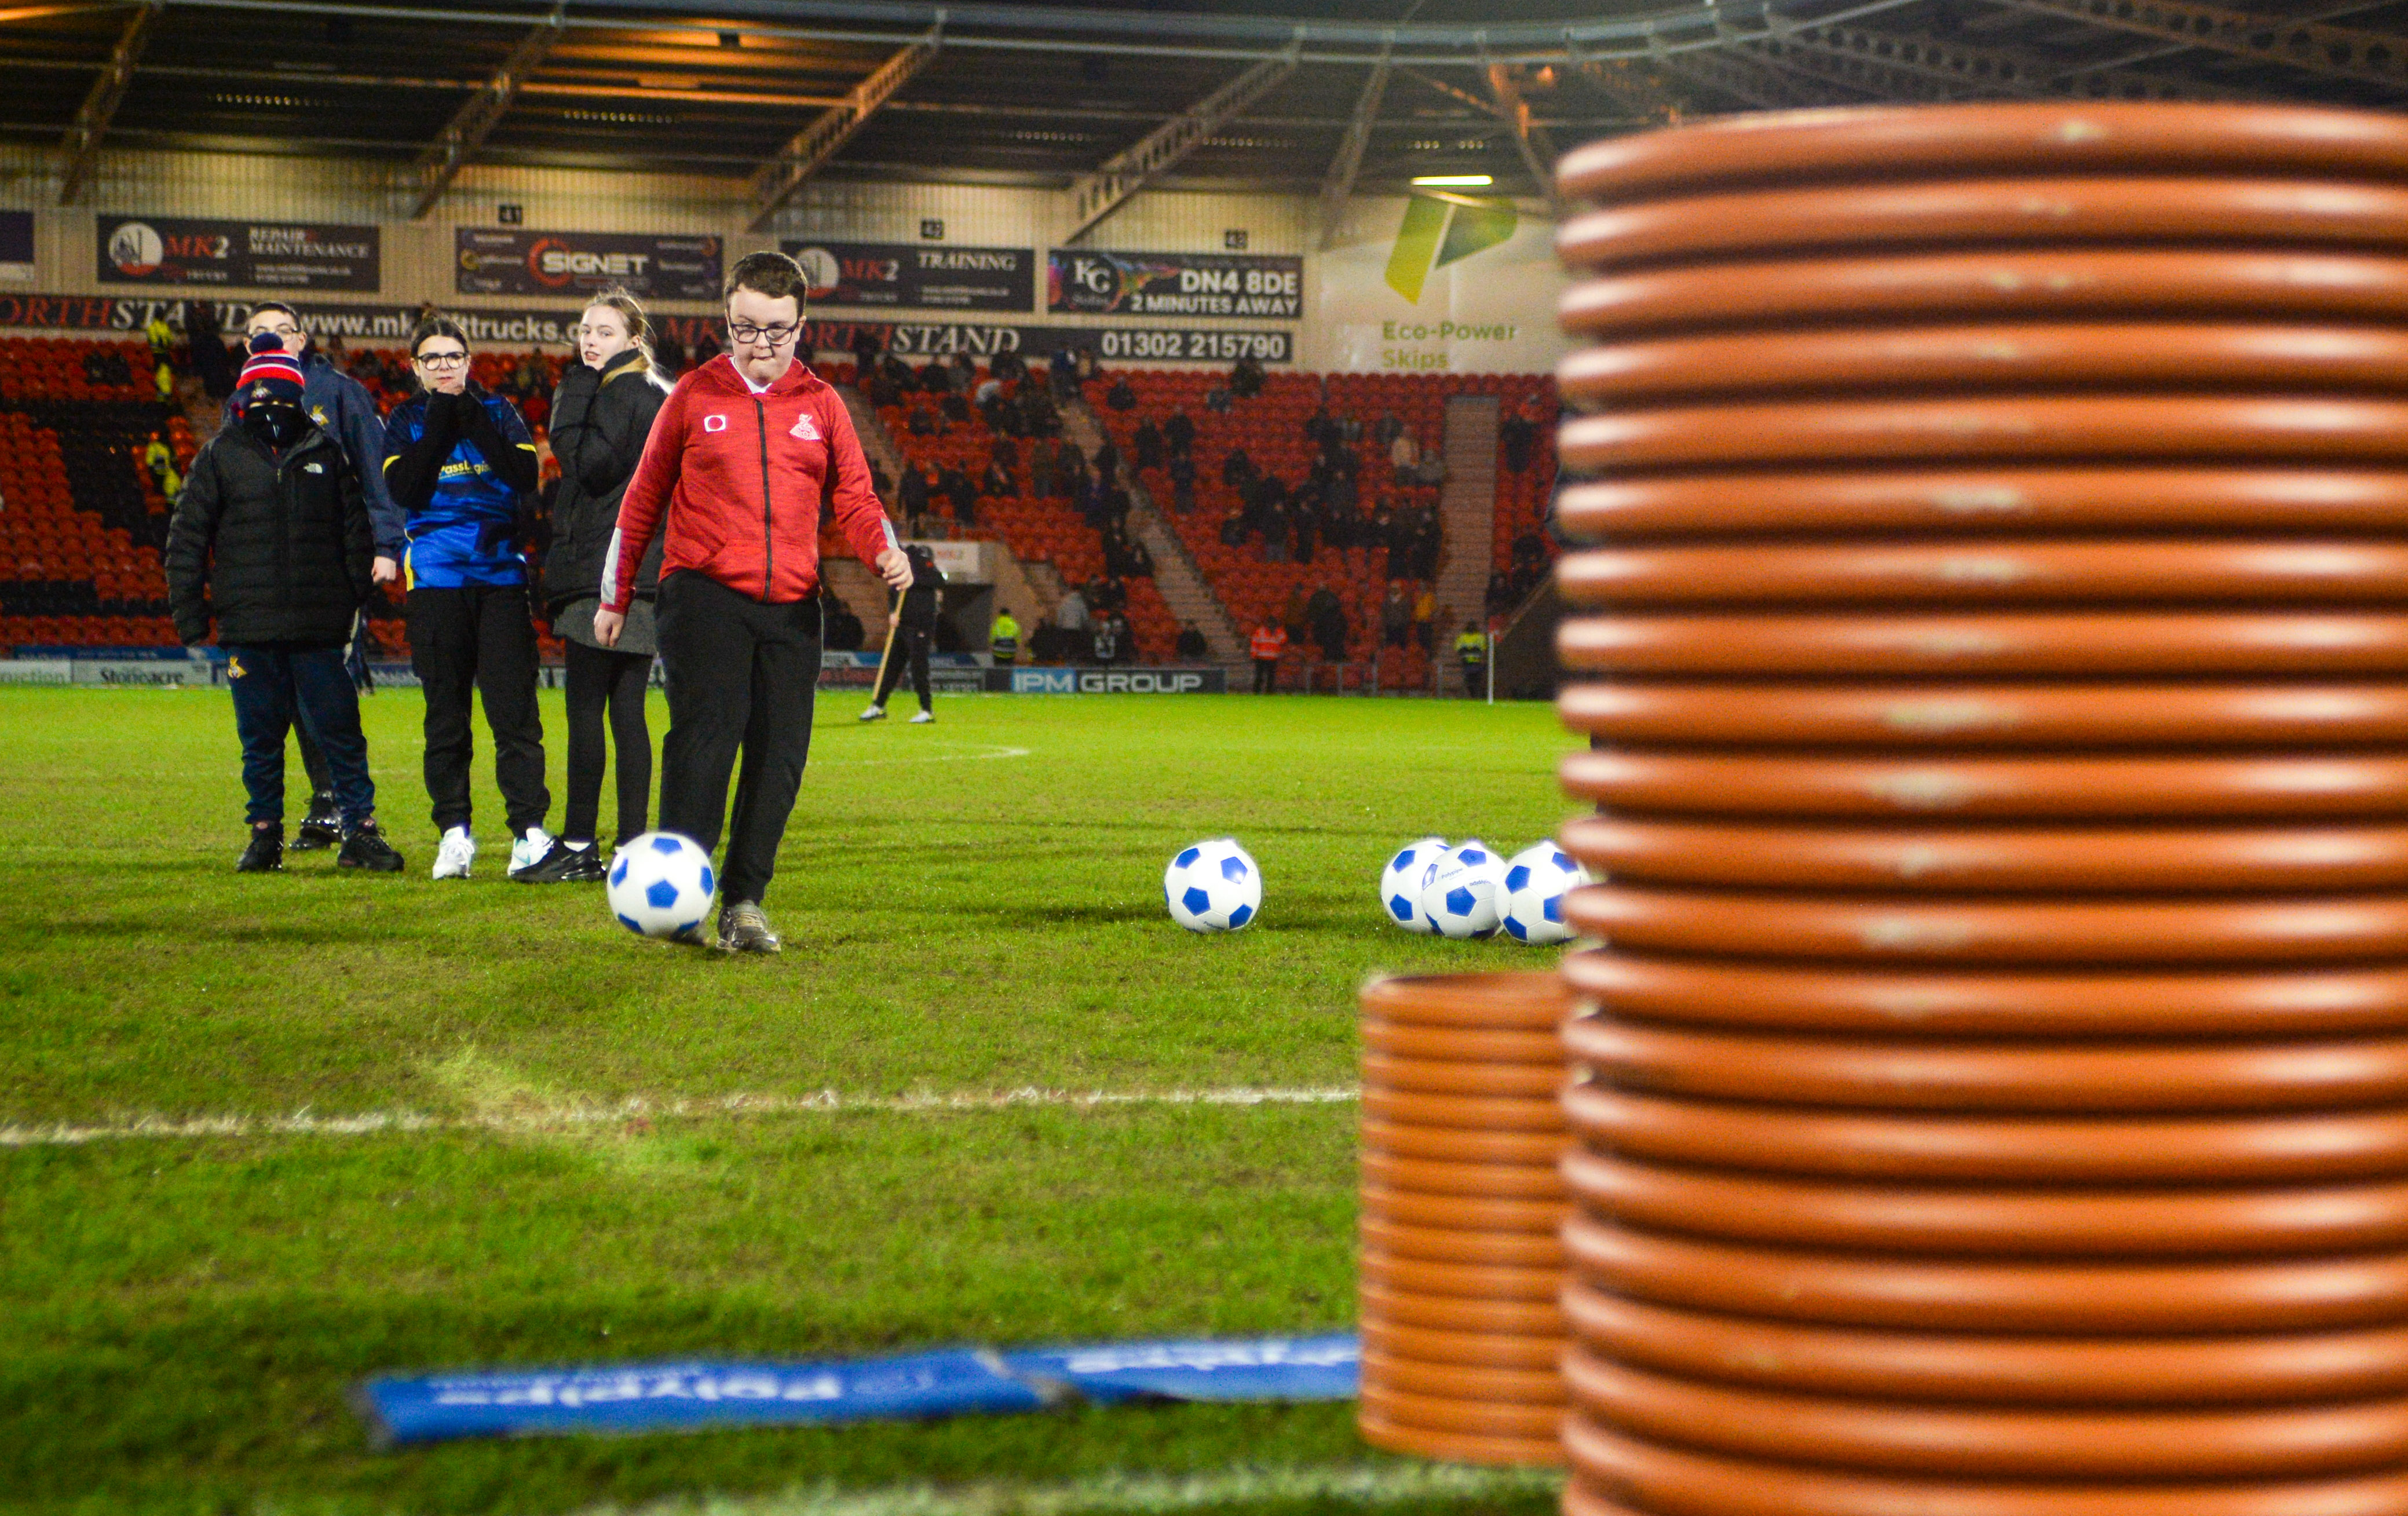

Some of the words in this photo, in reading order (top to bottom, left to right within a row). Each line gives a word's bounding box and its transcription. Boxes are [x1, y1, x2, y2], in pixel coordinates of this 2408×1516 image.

[249, 227, 305, 241] REPAIR
[165, 235, 229, 258] MK2
[249, 242, 369, 258] MAINTENANCE
[542, 253, 649, 275] SIGNET
[841, 258, 898, 282] MK2
[917, 251, 1017, 271] TRAINING
[1181, 269, 1240, 294] DN4
[1246, 270, 1298, 295] 8DE
[1131, 294, 1143, 312] 2
[1146, 294, 1232, 313] MINUTES
[1236, 297, 1298, 316] AWAY
[1382, 320, 1517, 341] Eco-Power
[1102, 331, 1181, 357] 01302
[1190, 333, 1285, 359] 215790
[1382, 349, 1448, 370] Skips
[1015, 673, 1073, 693] IPM
[1080, 674, 1203, 693] GROUP
